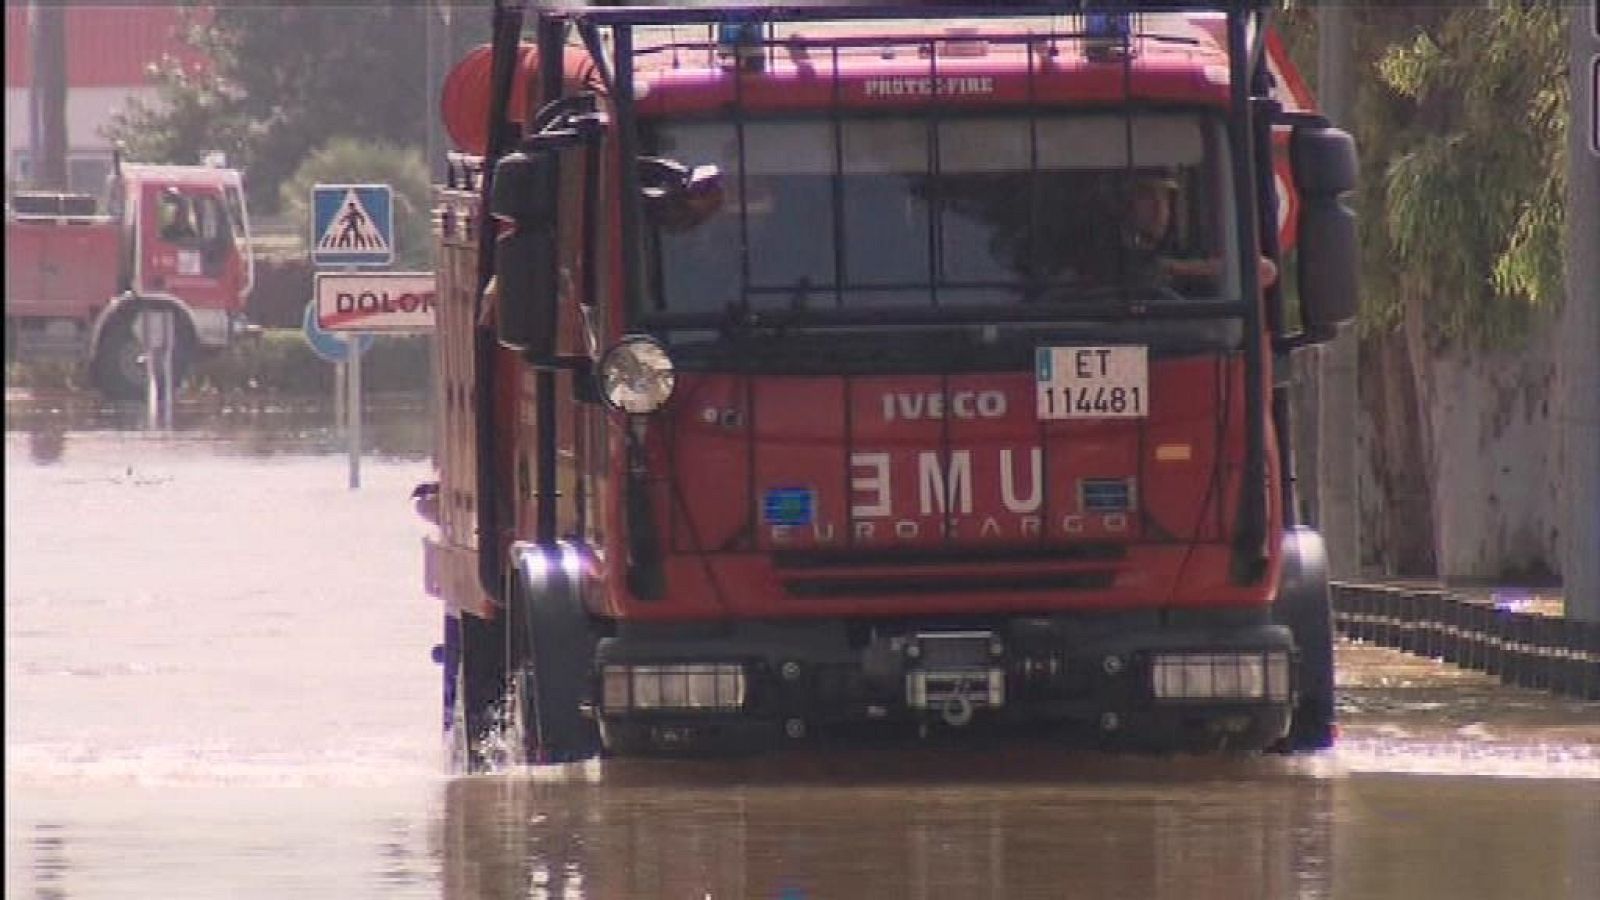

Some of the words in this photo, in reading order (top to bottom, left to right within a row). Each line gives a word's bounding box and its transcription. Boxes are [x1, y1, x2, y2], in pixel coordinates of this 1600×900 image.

[1075, 349, 1112, 379] ET
[882, 389, 1007, 421] IVECO
[1046, 386, 1140, 413] 114481
